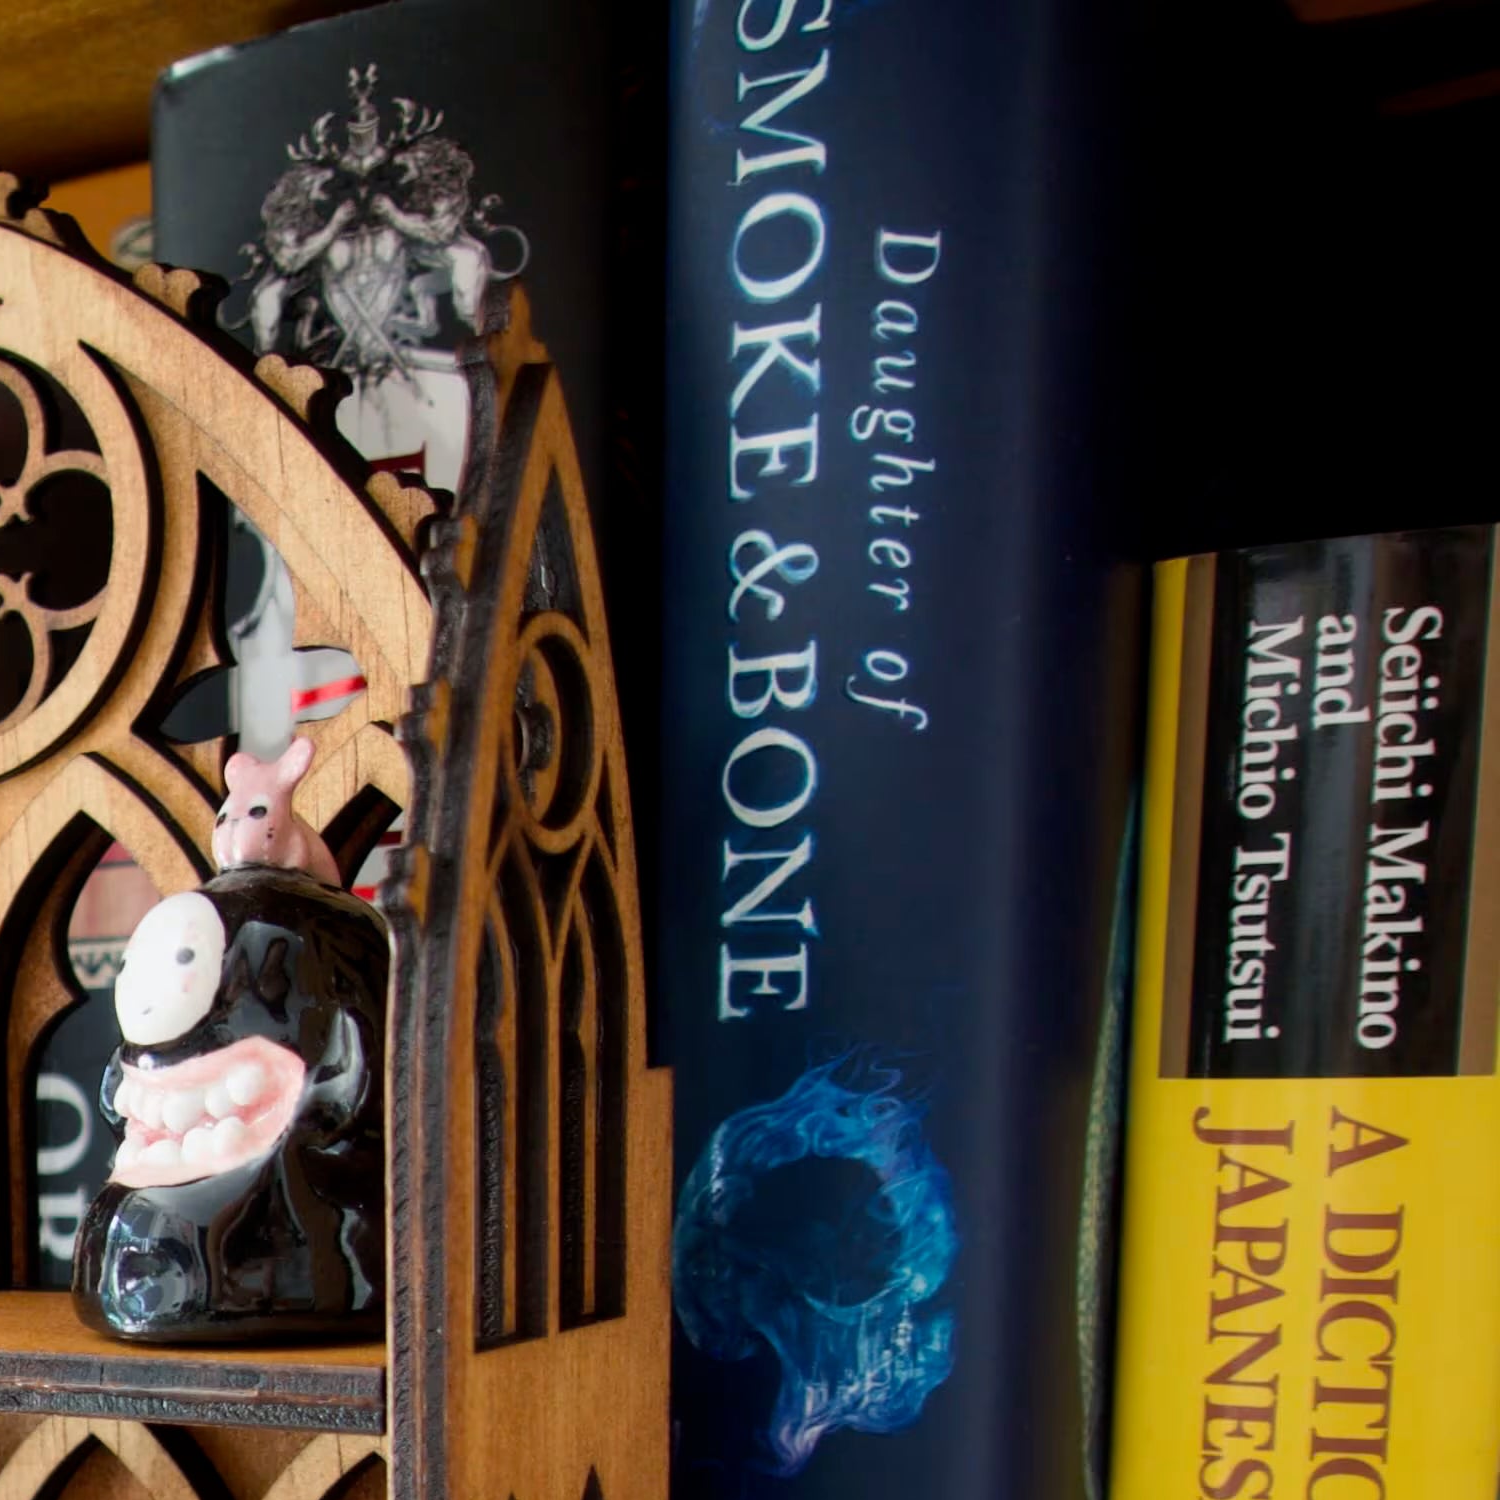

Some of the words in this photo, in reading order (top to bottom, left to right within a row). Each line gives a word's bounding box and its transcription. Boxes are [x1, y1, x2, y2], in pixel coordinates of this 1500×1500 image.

[727, 0, 831, 500] SMOKE
[851, 228, 942, 612] Daughter
[728, 530, 819, 622] &
[1311, 614, 1372, 728] and
[847, 650, 928, 731] of
[1237, 615, 1304, 820] Michio
[1371, 605, 1443, 804] Seiichi
[716, 640, 819, 1022] BONE
[1221, 832, 1291, 1043] Tsutsui
[1357, 822, 1429, 1050] Makino
[1326, 1105, 1410, 1177] A
